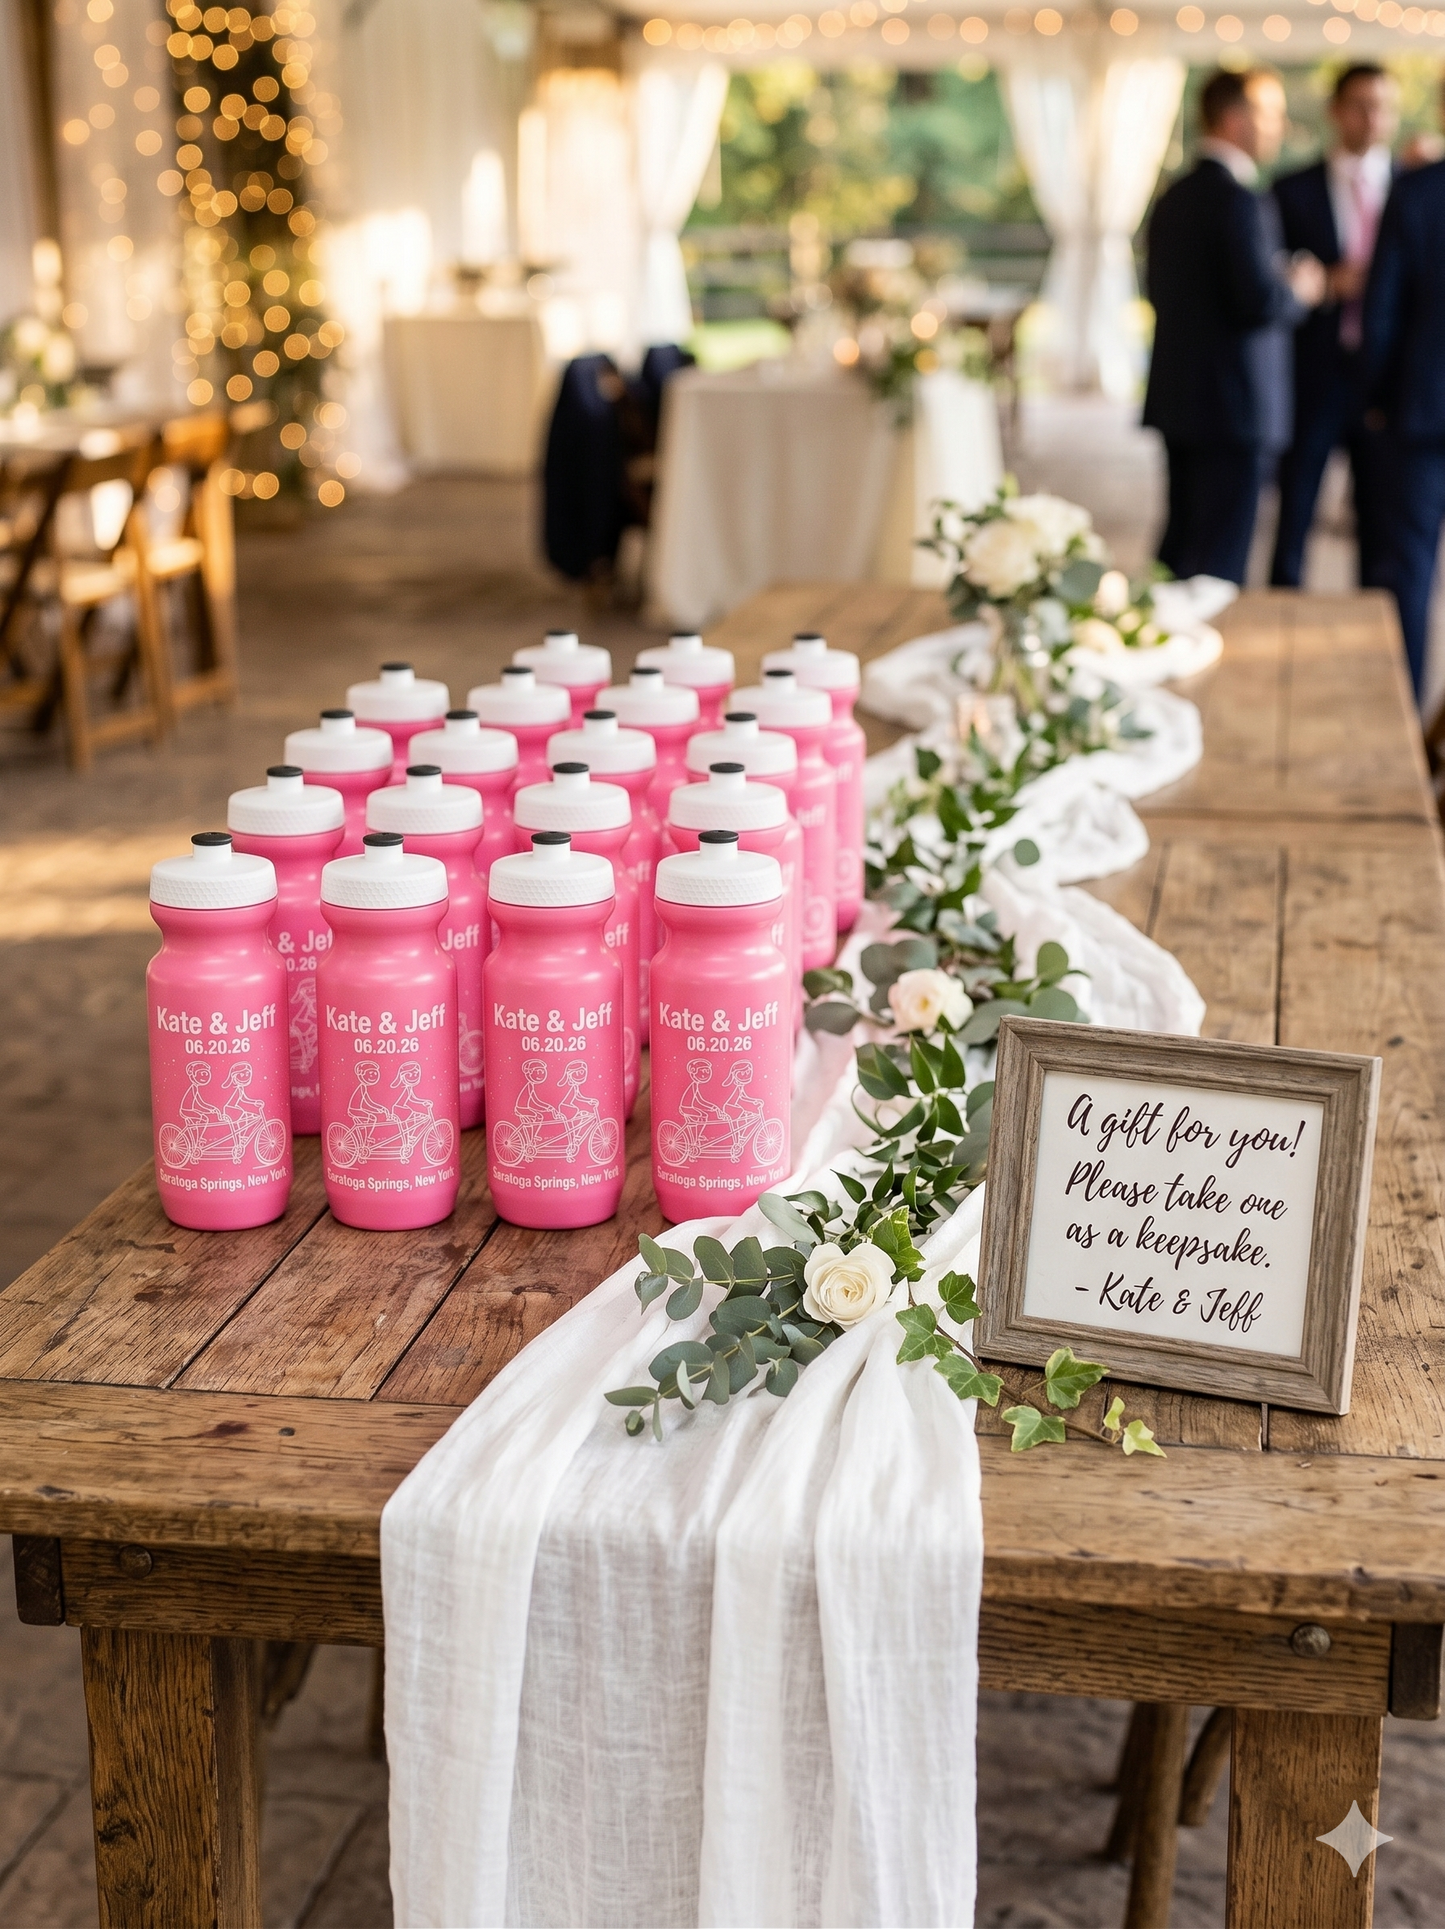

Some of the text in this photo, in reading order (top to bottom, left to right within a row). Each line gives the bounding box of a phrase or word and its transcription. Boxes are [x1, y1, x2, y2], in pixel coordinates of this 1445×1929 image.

[277, 931, 295, 953] &
[441, 924, 480, 951] Jeff
[604, 923, 629, 948] eff
[157, 1003, 276, 1036] Kate & Jeff
[326, 1003, 446, 1036] Kate & Jeff
[494, 1001, 613, 1033] Kate & Jeff
[659, 1001, 779, 1033] Kate & Jeff
[185, 1037, 251, 1055] 06.20.26
[354, 1037, 419, 1055] 06.20.26
[521, 1035, 587, 1053] 06.20.26
[686, 1035, 752, 1053] 06.20.26
[1067, 1093, 1306, 1168] A gift for you!
[200, 1177, 245, 1193] Springs,
[247, 1173, 268, 1187] New
[367, 1177, 412, 1193] Springs,
[415, 1173, 436, 1187] New
[492, 1166, 532, 1189] Saratoga
[534, 1175, 579, 1191] Springs,
[581, 1173, 602, 1186] New
[698, 1175, 744, 1191] Springs,
[746, 1174, 767, 1187] New
[1065, 1159, 1288, 1221] Please take one
[1065, 1215, 1272, 1271] as a keepsake.
[1099, 1271, 1165, 1315] Kate
[1172, 1289, 1192, 1315] &
[1200, 1287, 1264, 1333] Jeff
